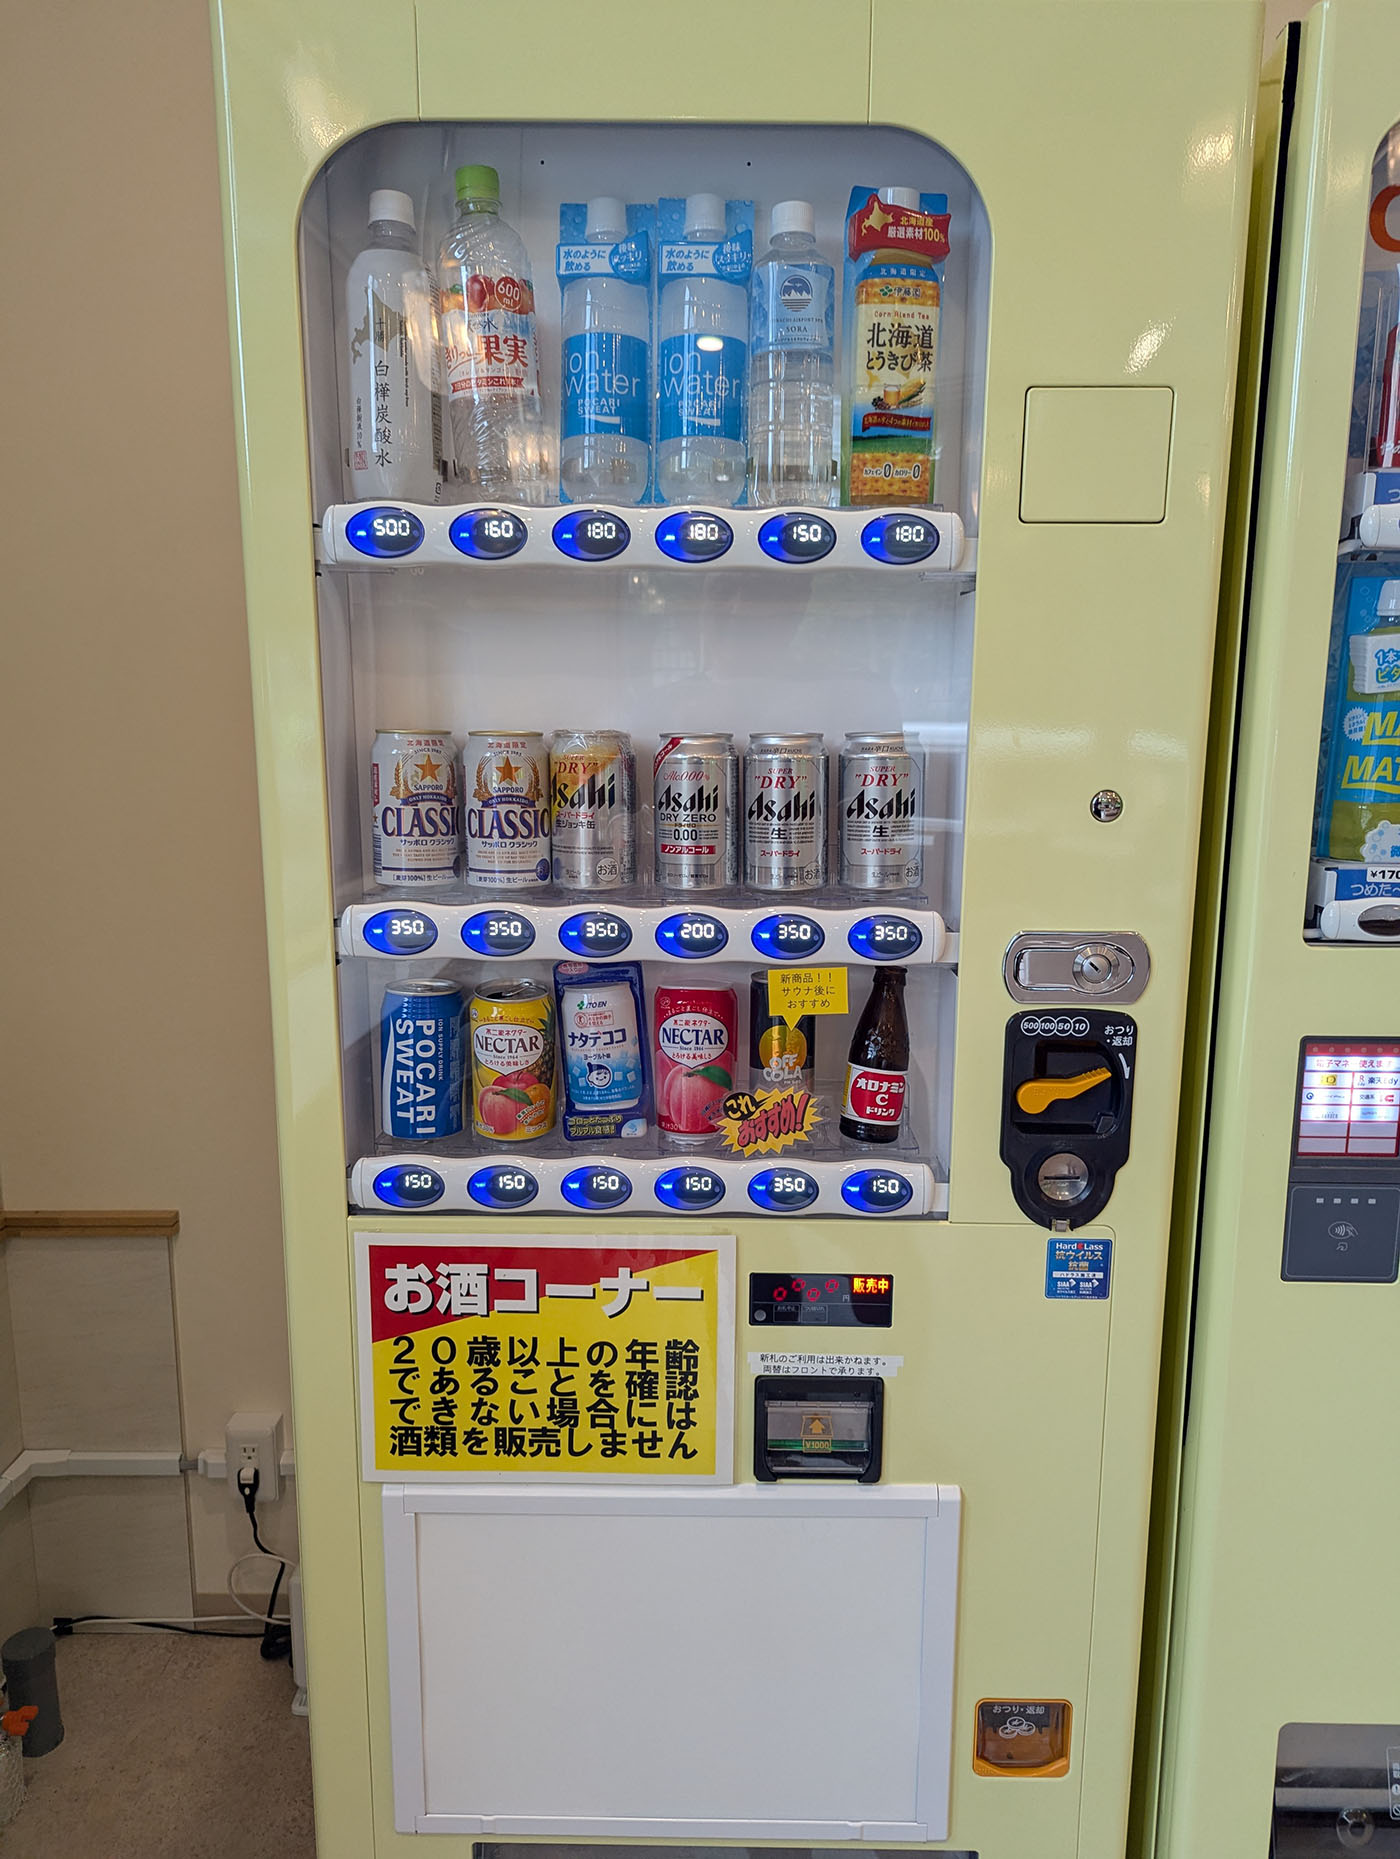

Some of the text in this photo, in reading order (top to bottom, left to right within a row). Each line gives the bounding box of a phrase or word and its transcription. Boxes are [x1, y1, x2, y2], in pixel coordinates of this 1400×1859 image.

[900, 216, 933, 227] 北海道産
[887, 226, 945, 243] 厳選素材100%
[563, 249, 607, 260] 水のように
[665, 249, 710, 260] 水のように
[565, 261, 591, 272] 飲める
[666, 261, 694, 272] 飲める
[497, 281, 520, 301] 600
[874, 310, 891, 318] Corn
[917, 312, 930, 320] Tea
[786, 325, 808, 333] SORA
[867, 323, 934, 349] 北海道
[565, 350, 600, 376] ion
[664, 350, 700, 376] ion
[866, 351, 934, 372] とうきび茶
[565, 369, 641, 398] water
[664, 371, 740, 399] water
[577, 398, 620, 408] POCARI
[373, 360, 393, 468] 白樺炭酸水
[577, 406, 617, 416] SWEAT
[373, 518, 924, 543] 500 160 180 180 150 180
[413, 783, 444, 791] SAPPORO
[658, 784, 719, 812] Asahi
[846, 788, 916, 819] Asahi
[748, 791, 816, 822] Asahi
[467, 808, 550, 839] CLASSIC
[660, 813, 717, 822] DRY ZERO
[556, 820, 596, 829] 生ジョッキ缶
[673, 829, 698, 841] 0.00
[771, 827, 788, 840] 生
[872, 825, 890, 838] 生
[400, 838, 428, 847] サッポロ
[508, 840, 538, 848] クラシック
[664, 845, 710, 854] ノンアルコール
[597, 864, 618, 876] お酒
[905, 866, 920, 878] お酒
[391, 919, 908, 942] 350 350 350 200 350 350
[781, 985, 836, 996] サウナ後に
[598, 1000, 607, 1008] EN
[787, 999, 831, 1009] おすすめ
[1023, 1021, 1086, 1030] 500 100 50 10
[1104, 1024, 1134, 1035] おつり
[568, 1028, 627, 1048] ナタデココ
[662, 1027, 724, 1045] NECTAR
[475, 1033, 540, 1054] NECTAR
[583, 1053, 611, 1061] ヨーグルト味
[769, 1053, 799, 1070] OFF
[395, 1018, 414, 1124] SWEAT
[415, 1019, 436, 1134] POCARI
[762, 1066, 804, 1082] COLA
[856, 1077, 905, 1094] オロナミン
[725, 1093, 757, 1117] これ
[875, 1094, 889, 1106] C
[865, 1106, 895, 1117] ドリンク
[404, 1174, 899, 1194] 150 150 150 150 350 150
[1055, 1250, 1103, 1260] 抗ウイルス
[384, 1262, 704, 1319] お酒コーナー
[852, 1277, 889, 1294] 販売中
[842, 1294, 850, 1302] 円
[391, 1335, 700, 1372] 20歳以上の年齢
[760, 1353, 886, 1366] 新札のご利用は出来かねます。
[763, 1364, 880, 1376] 両替はフロントで承ります。
[389, 1367, 700, 1402] であることを確認
[389, 1397, 698, 1431] できない場合には
[389, 1425, 699, 1460] 酒類を販売しません
[805, 1441, 830, 1449] ¥1000
[993, 1705, 1045, 1715] おつり・返却
